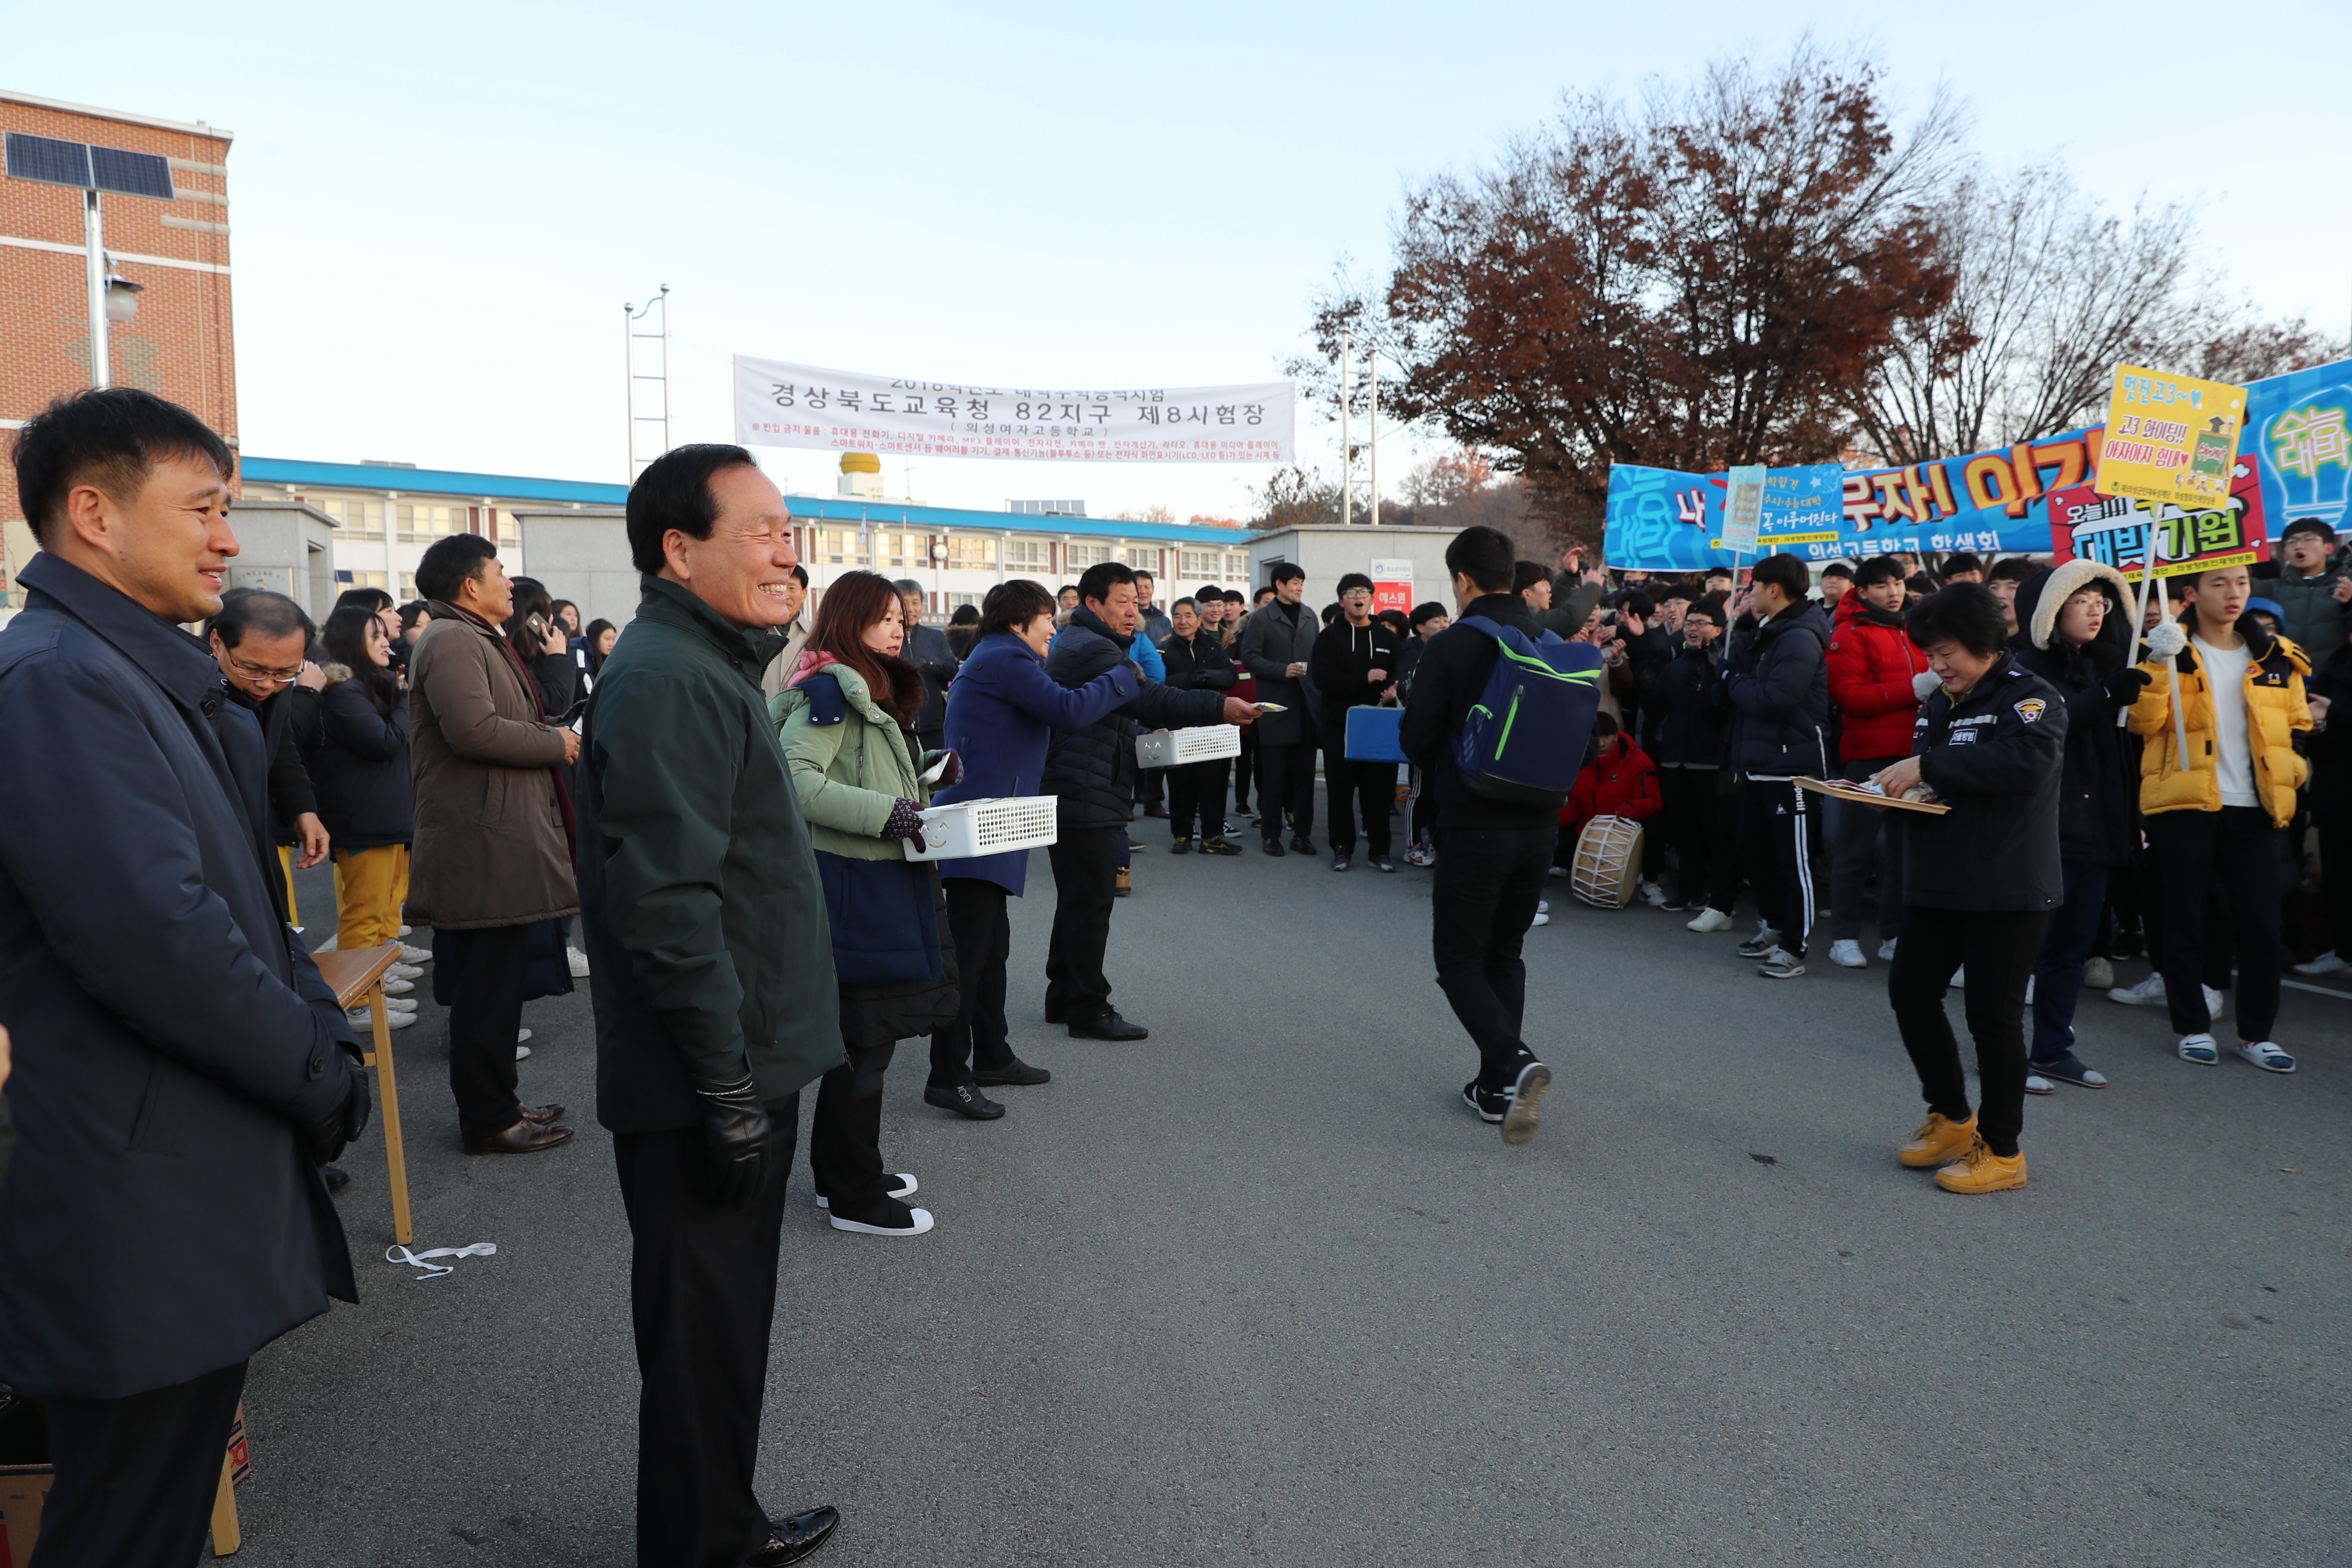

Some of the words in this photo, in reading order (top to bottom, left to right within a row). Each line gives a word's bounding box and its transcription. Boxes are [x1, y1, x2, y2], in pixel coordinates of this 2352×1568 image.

[772, 383, 989, 420] 경상북도교육청
[1016, 402, 1112, 424] 82지구
[1138, 404, 1265, 425] 제8시험장
[763, 423, 780, 433] 반입
[784, 424, 800, 434] 금지
[804, 426, 821, 435] 물품
[831, 427, 858, 438] 휴대용
[898, 432, 924, 441] 디지털
[1069, 439, 1094, 448] 카메라
[1194, 441, 1216, 450] 휴대용
[1221, 441, 1243, 449] 미디어
[2118, 415, 2141, 435] 고3
[2274, 408, 2344, 443] 수능
[924, 444, 932, 453] 등
[1098, 450, 1113, 459] 또는
[1116, 450, 1138, 460] 전자식
[1239, 451, 1253, 460] 있는
[1256, 451, 1270, 459] 시계
[1273, 451, 1280, 460] 등
[2105, 439, 2154, 464] 아자아자
[2279, 432, 2351, 476] 대박
[1762, 511, 1774, 533] 꼭
[1776, 510, 1838, 529] 이루어진다
[1378, 592, 1406, 604] 에스원
